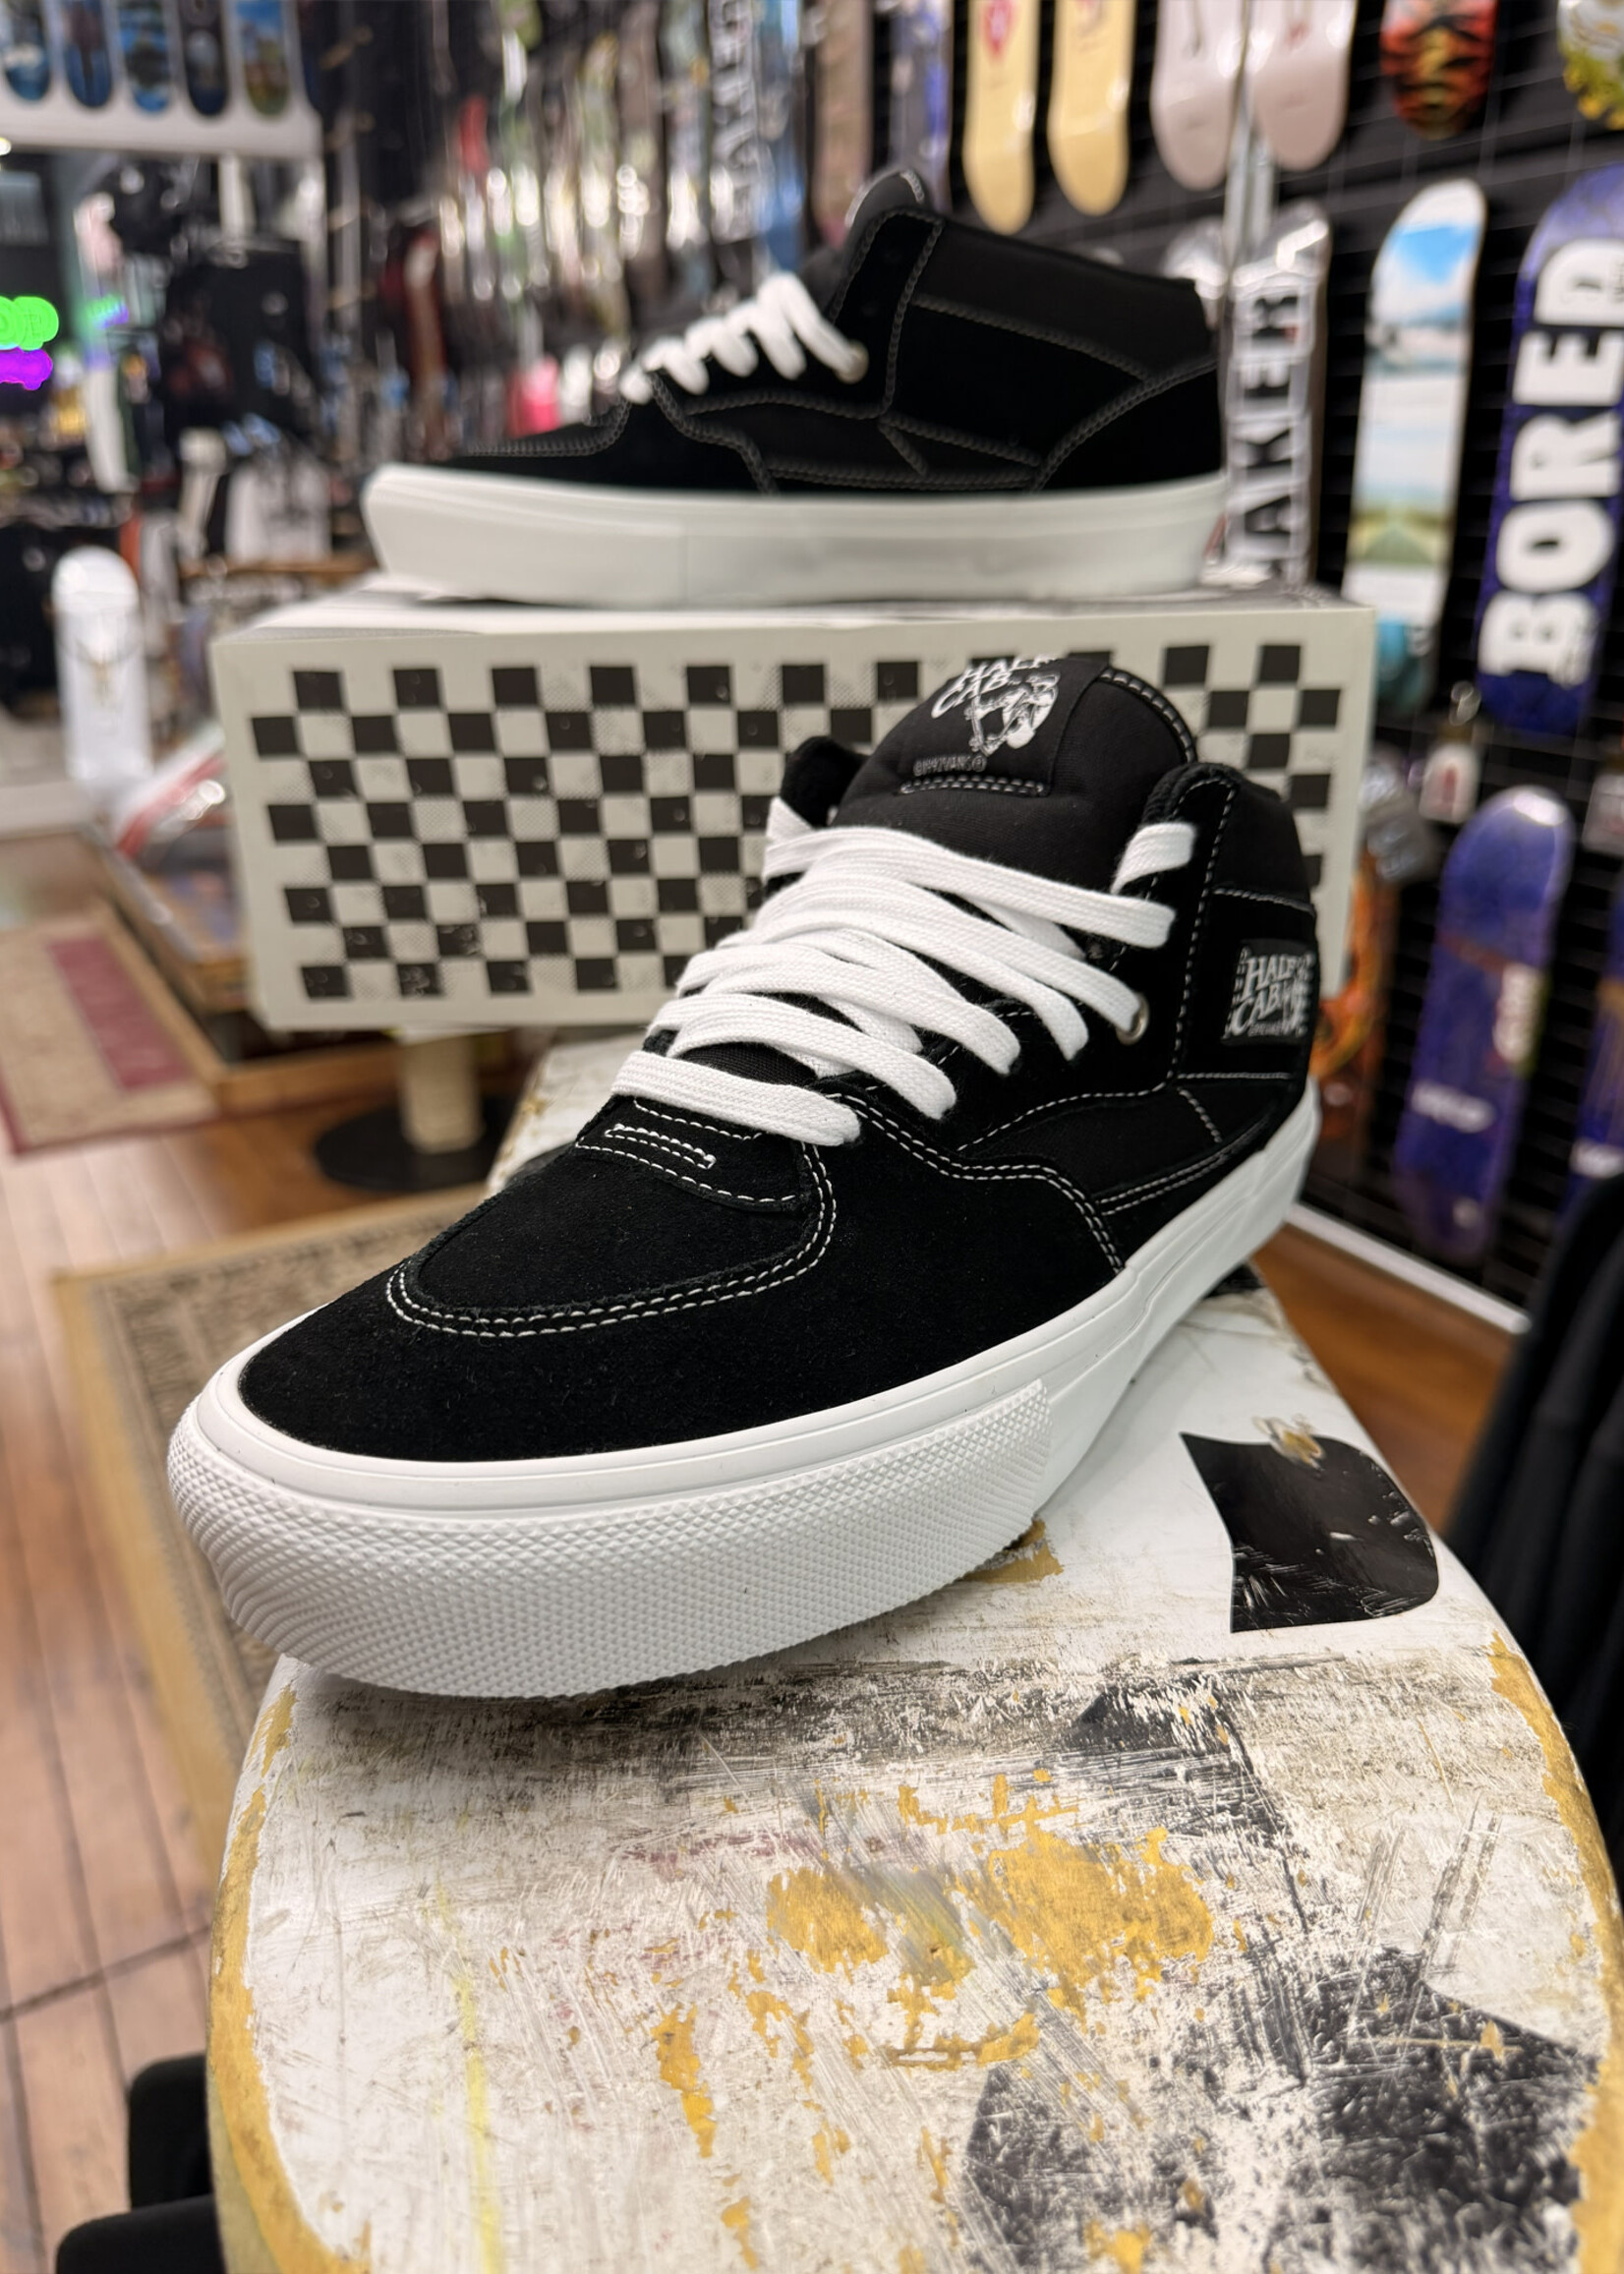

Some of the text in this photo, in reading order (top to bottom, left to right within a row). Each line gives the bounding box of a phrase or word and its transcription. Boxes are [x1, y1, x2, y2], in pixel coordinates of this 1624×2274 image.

[1225, 279, 1315, 586] AKER
[1478, 237, 1624, 686] BORED
[1230, 981, 1284, 1036] CAB
[1240, 954, 1298, 1002] HALF
